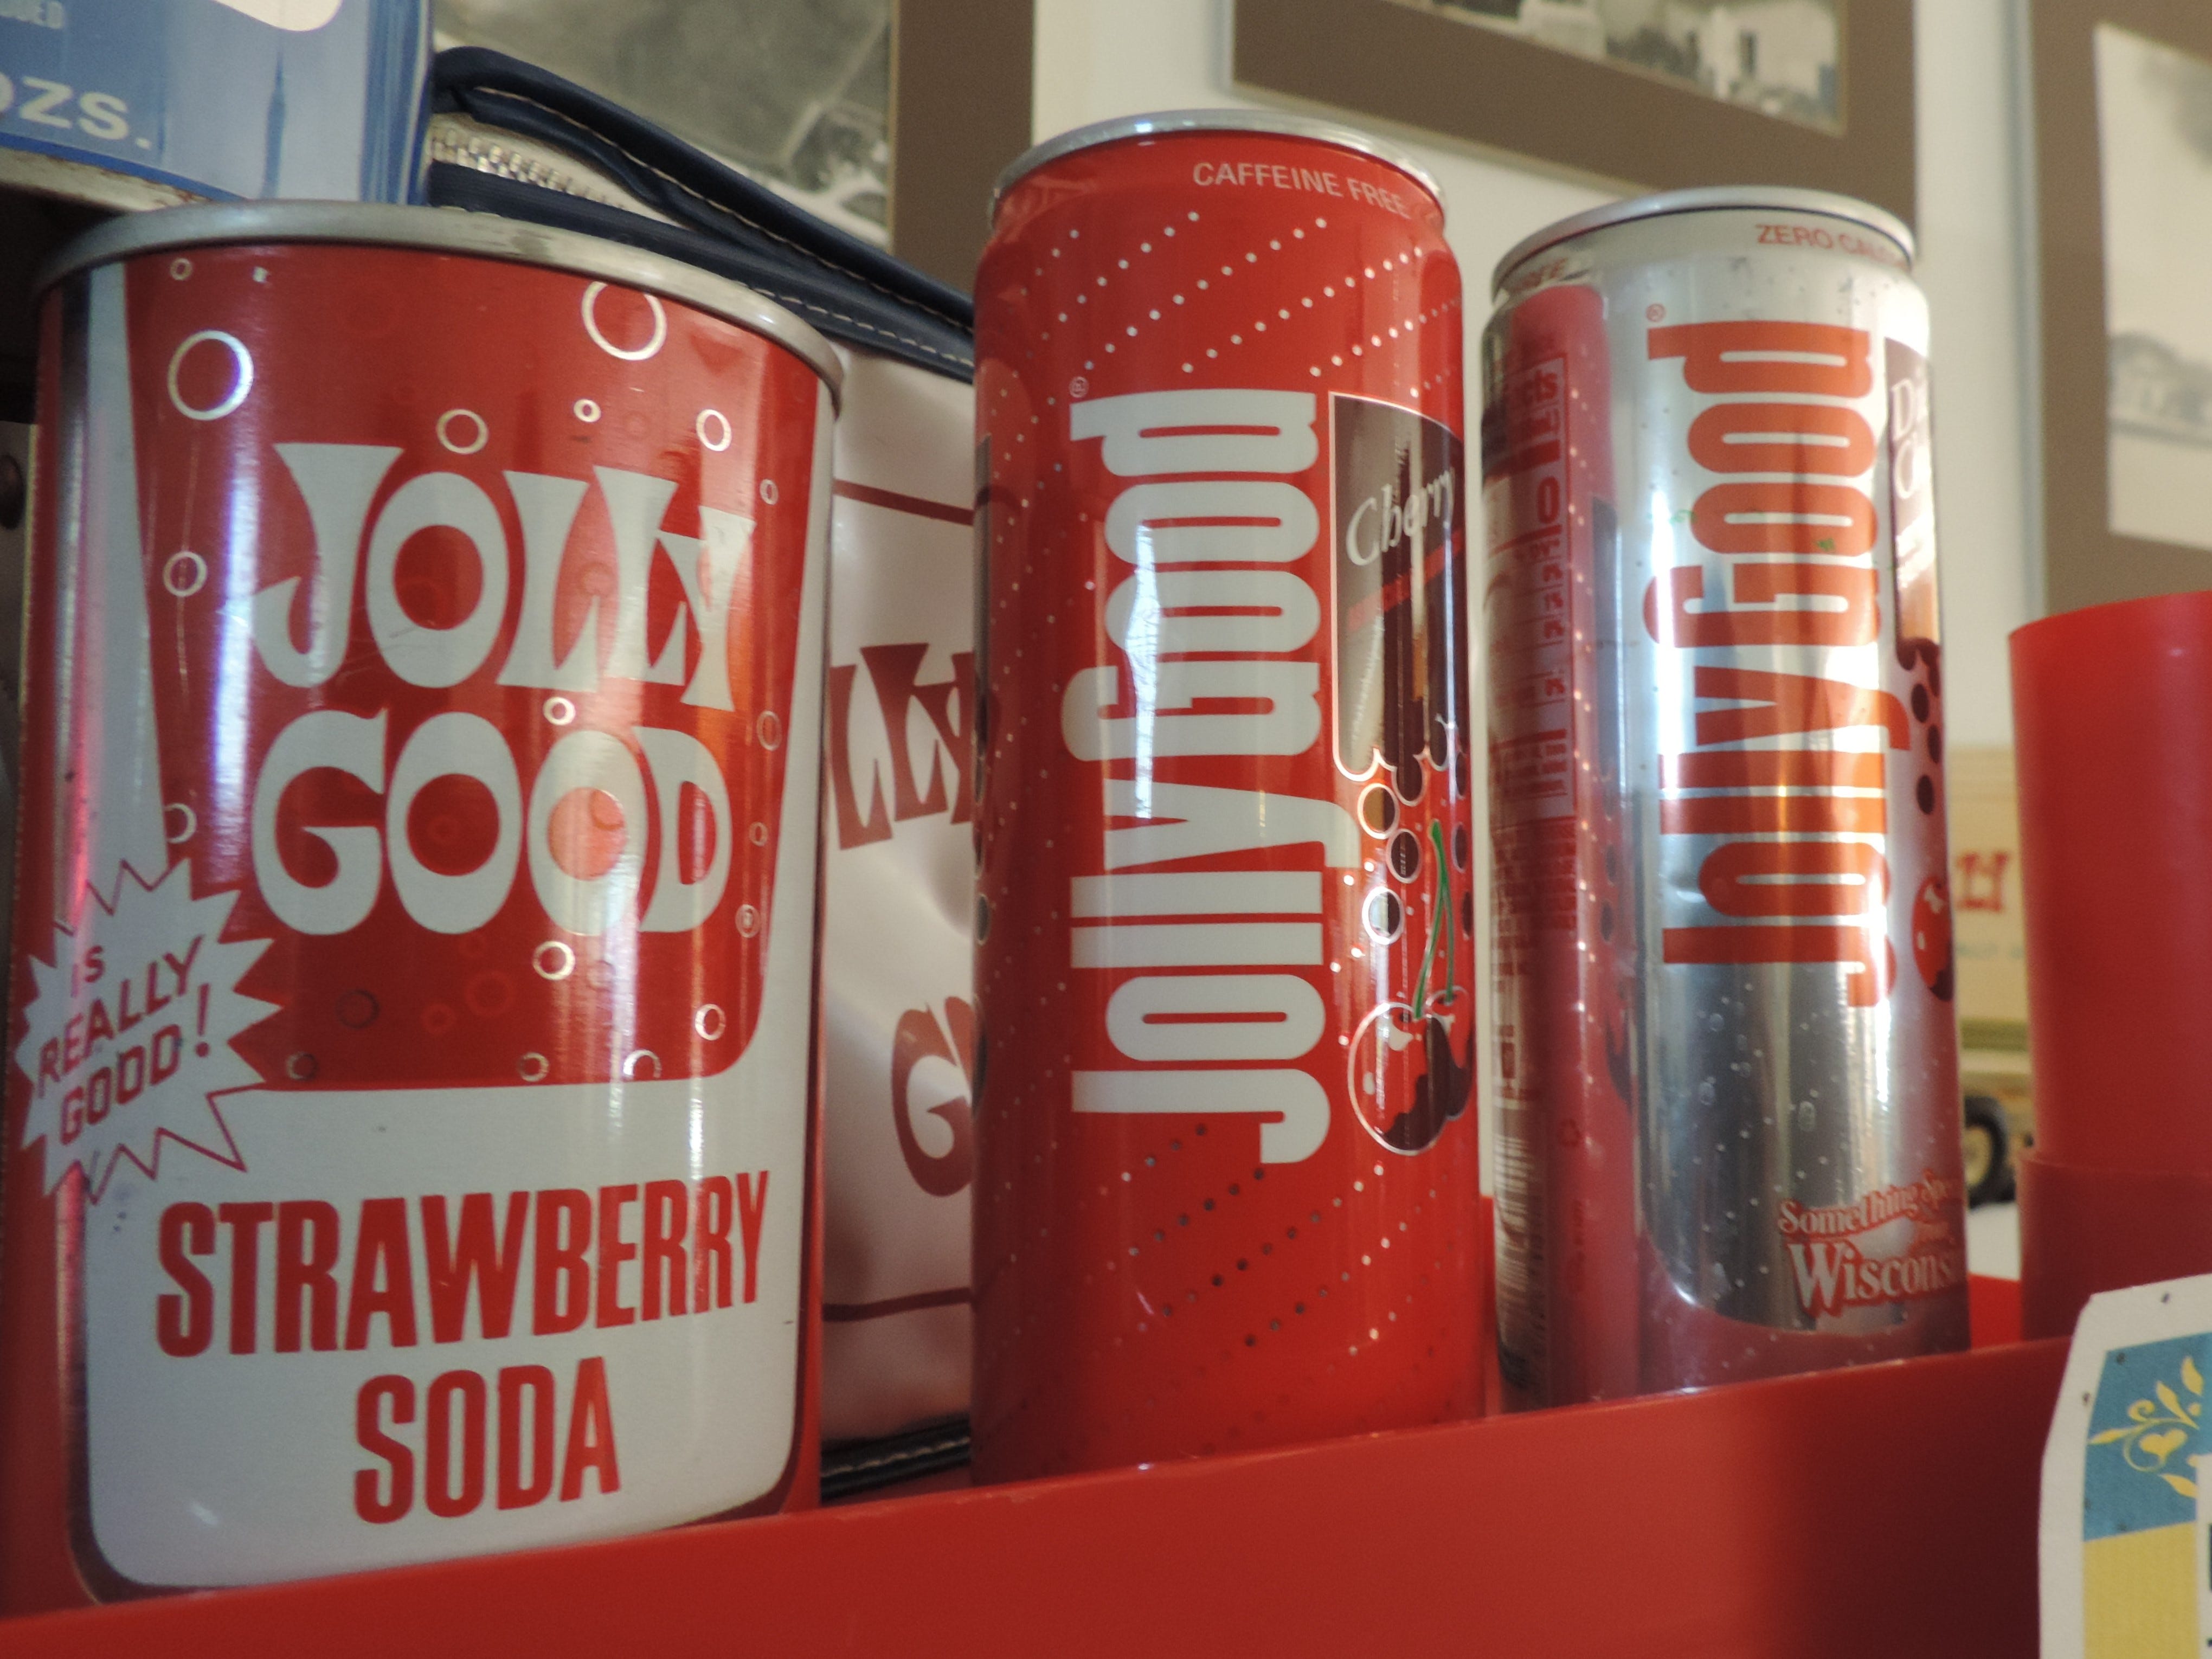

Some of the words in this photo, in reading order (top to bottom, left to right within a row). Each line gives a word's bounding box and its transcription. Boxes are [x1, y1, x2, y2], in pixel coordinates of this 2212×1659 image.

[0, 70, 152, 150] ZS.
[1193, 162, 1344, 198] CAFFEINE
[1347, 177, 1412, 220] FREE
[1755, 224, 1833, 249] ZERO
[252, 442, 757, 712] JOLLY
[252, 707, 734, 936] GOOD
[38, 934, 206, 1099] REALLY
[60, 982, 210, 1146] GOOD!
[156, 1169, 769, 1358] STRAWBERRY
[353, 1356, 621, 1524] SODA
